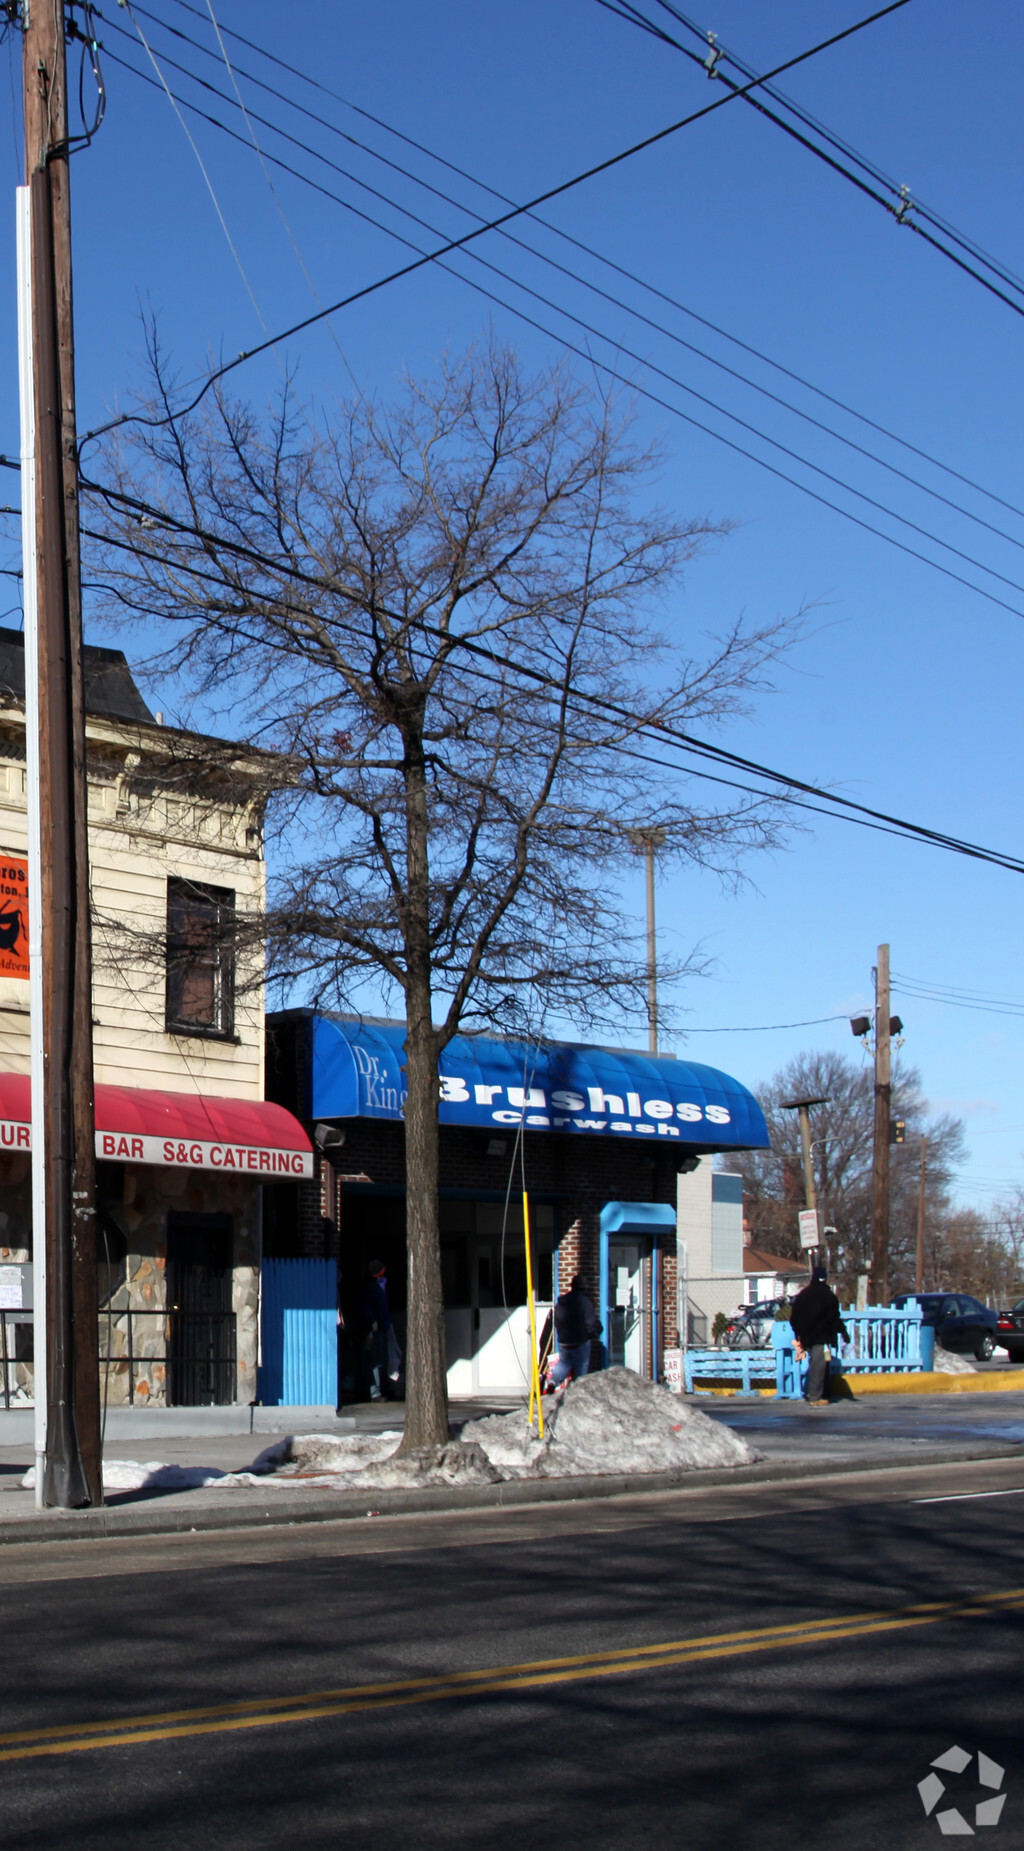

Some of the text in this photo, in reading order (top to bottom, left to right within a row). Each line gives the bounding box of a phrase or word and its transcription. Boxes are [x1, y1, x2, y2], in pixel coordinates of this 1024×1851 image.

[352, 1045, 388, 1077] Dr.
[438, 1075, 731, 1125] Brushless
[103, 1135, 144, 1158] BAR
[163, 1141, 203, 1164] S&G
[210, 1146, 304, 1174] CATERING
